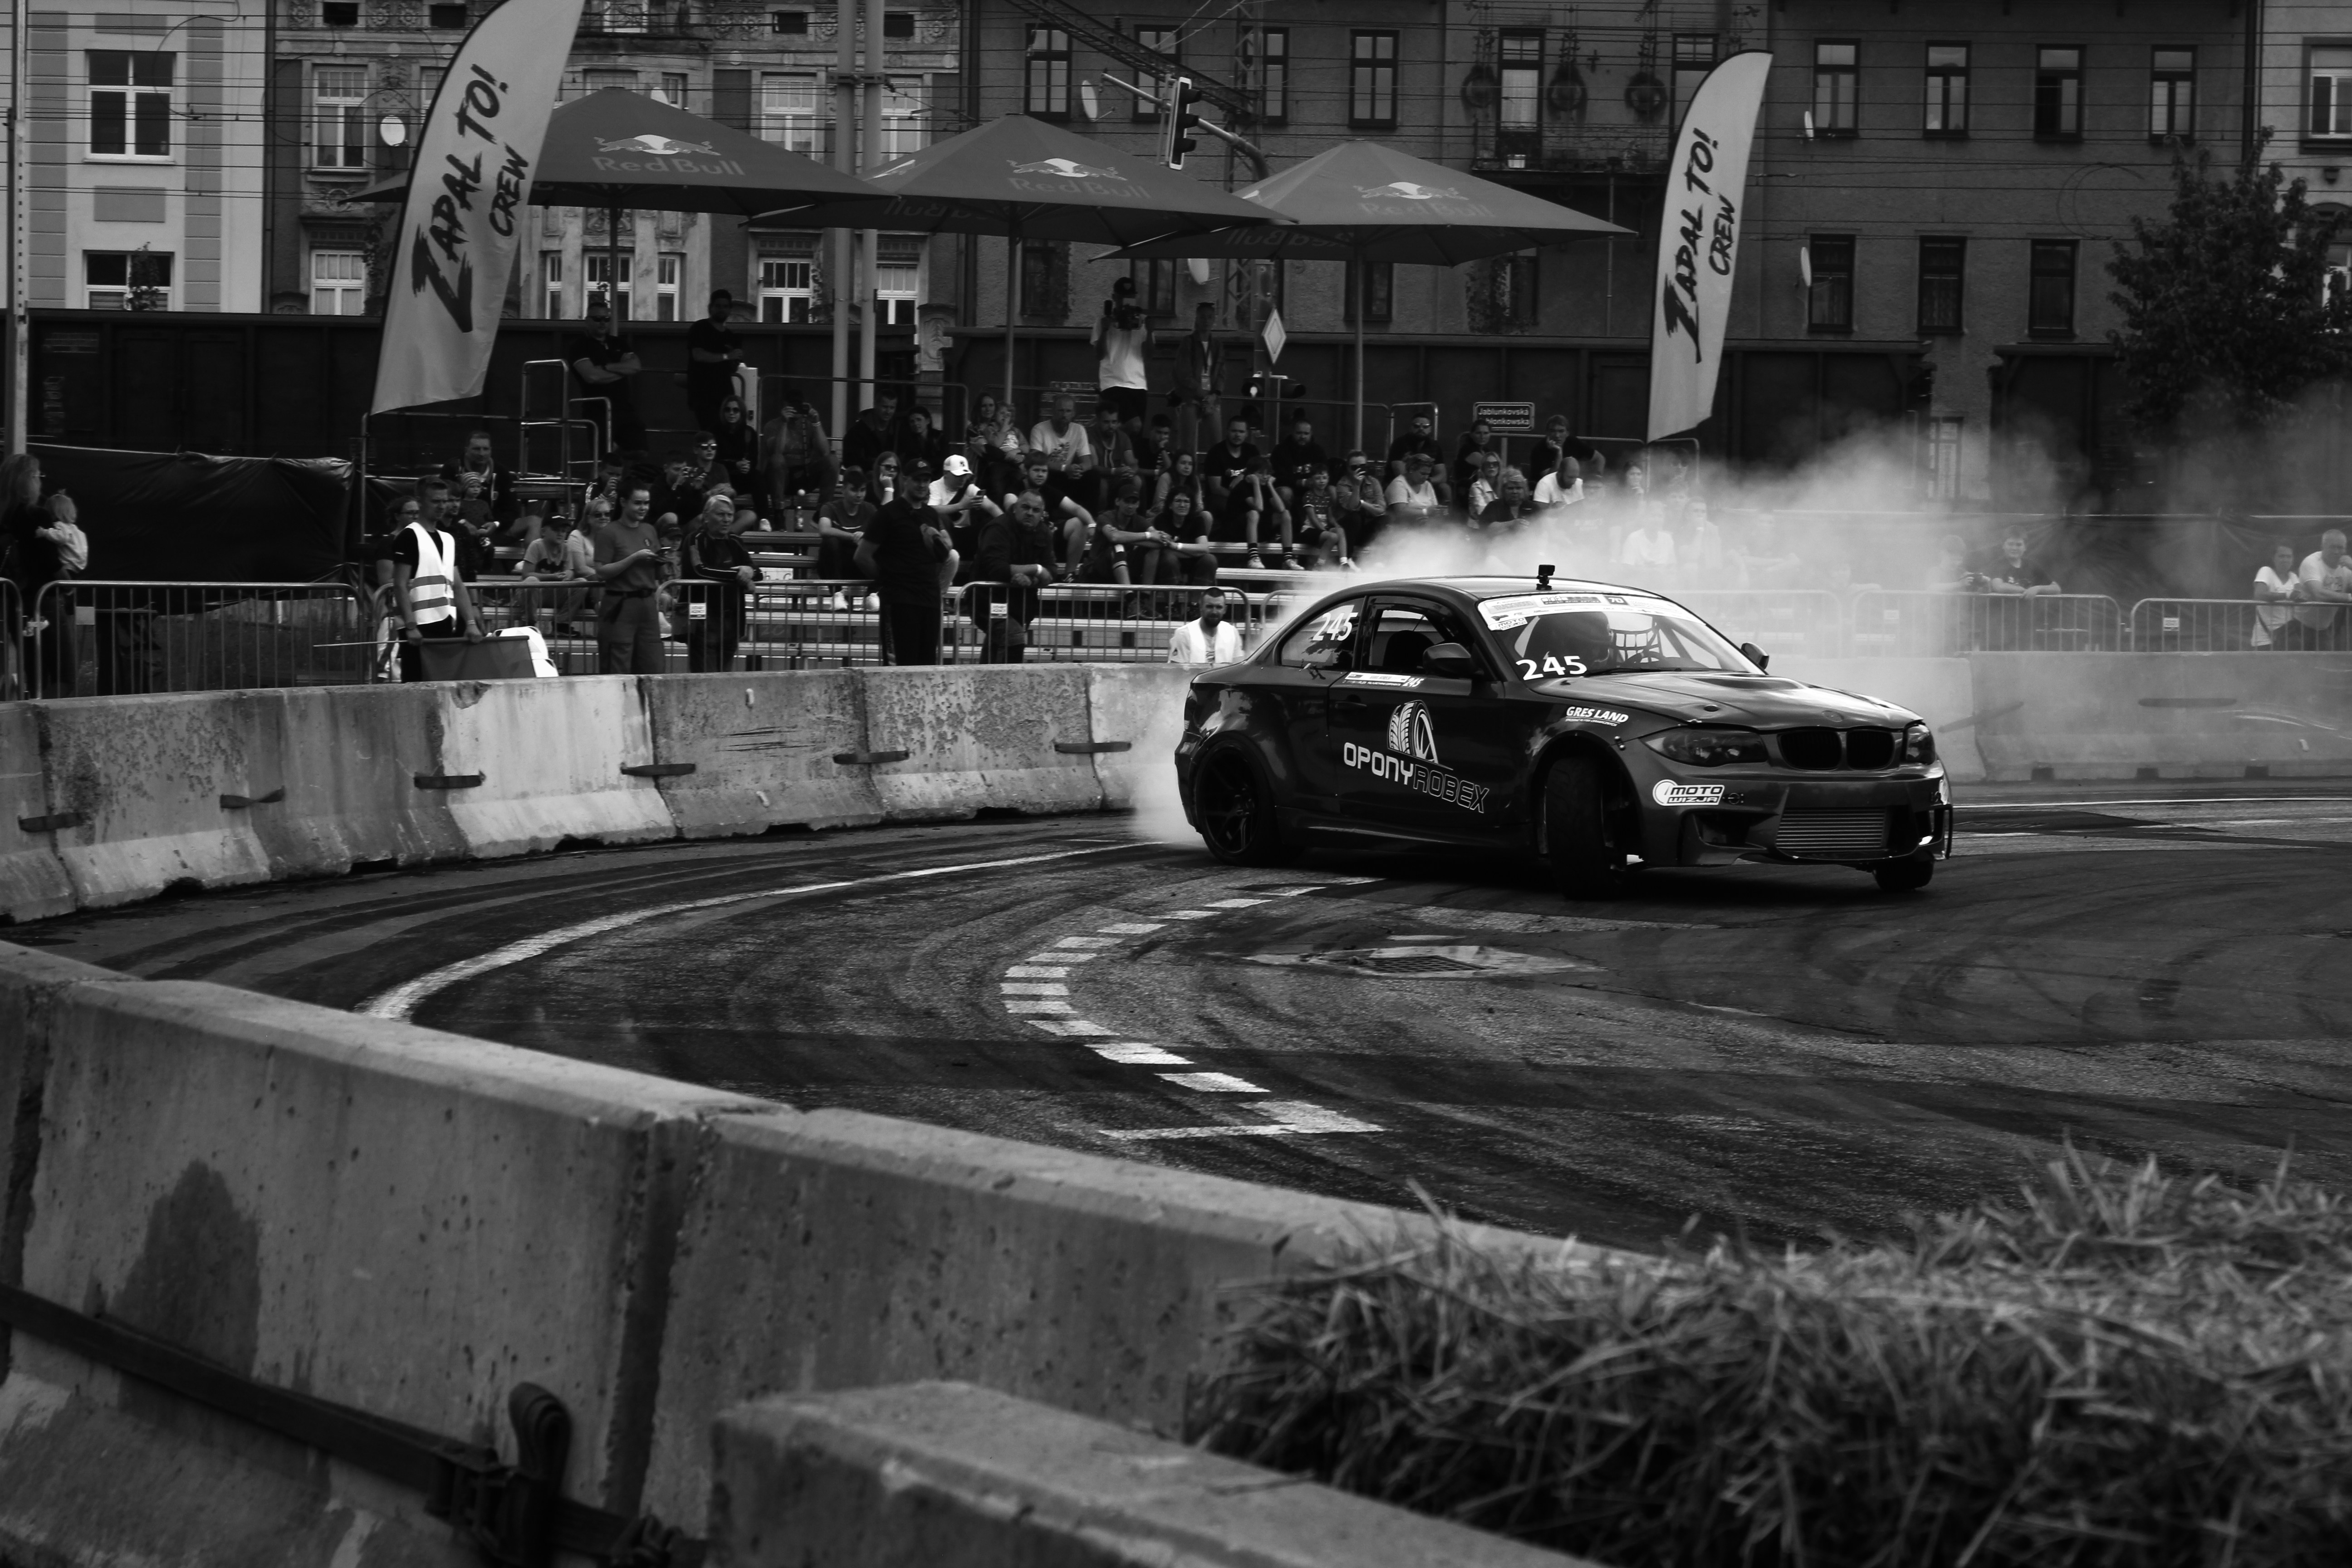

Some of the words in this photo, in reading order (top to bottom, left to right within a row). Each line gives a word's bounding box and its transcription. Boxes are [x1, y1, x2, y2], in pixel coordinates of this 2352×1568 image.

[1684, 127, 1719, 196] TO!
[411, 152, 482, 333] ZAPAL
[454, 63, 509, 145] TO!
[489, 142, 529, 237] CREW
[1708, 193, 1736, 276] CREW
[1478, 407, 1529, 416] Jablunkovská
[1312, 612, 1359, 641] 245
[1498, 617, 1525, 627] MOTO
[1515, 656, 1588, 681] 245
[1402, 677, 1425, 687] 245
[1566, 706, 1595, 717] GRES
[1593, 710, 1629, 723] LAND
[1671, 787, 1723, 795] MOTO
